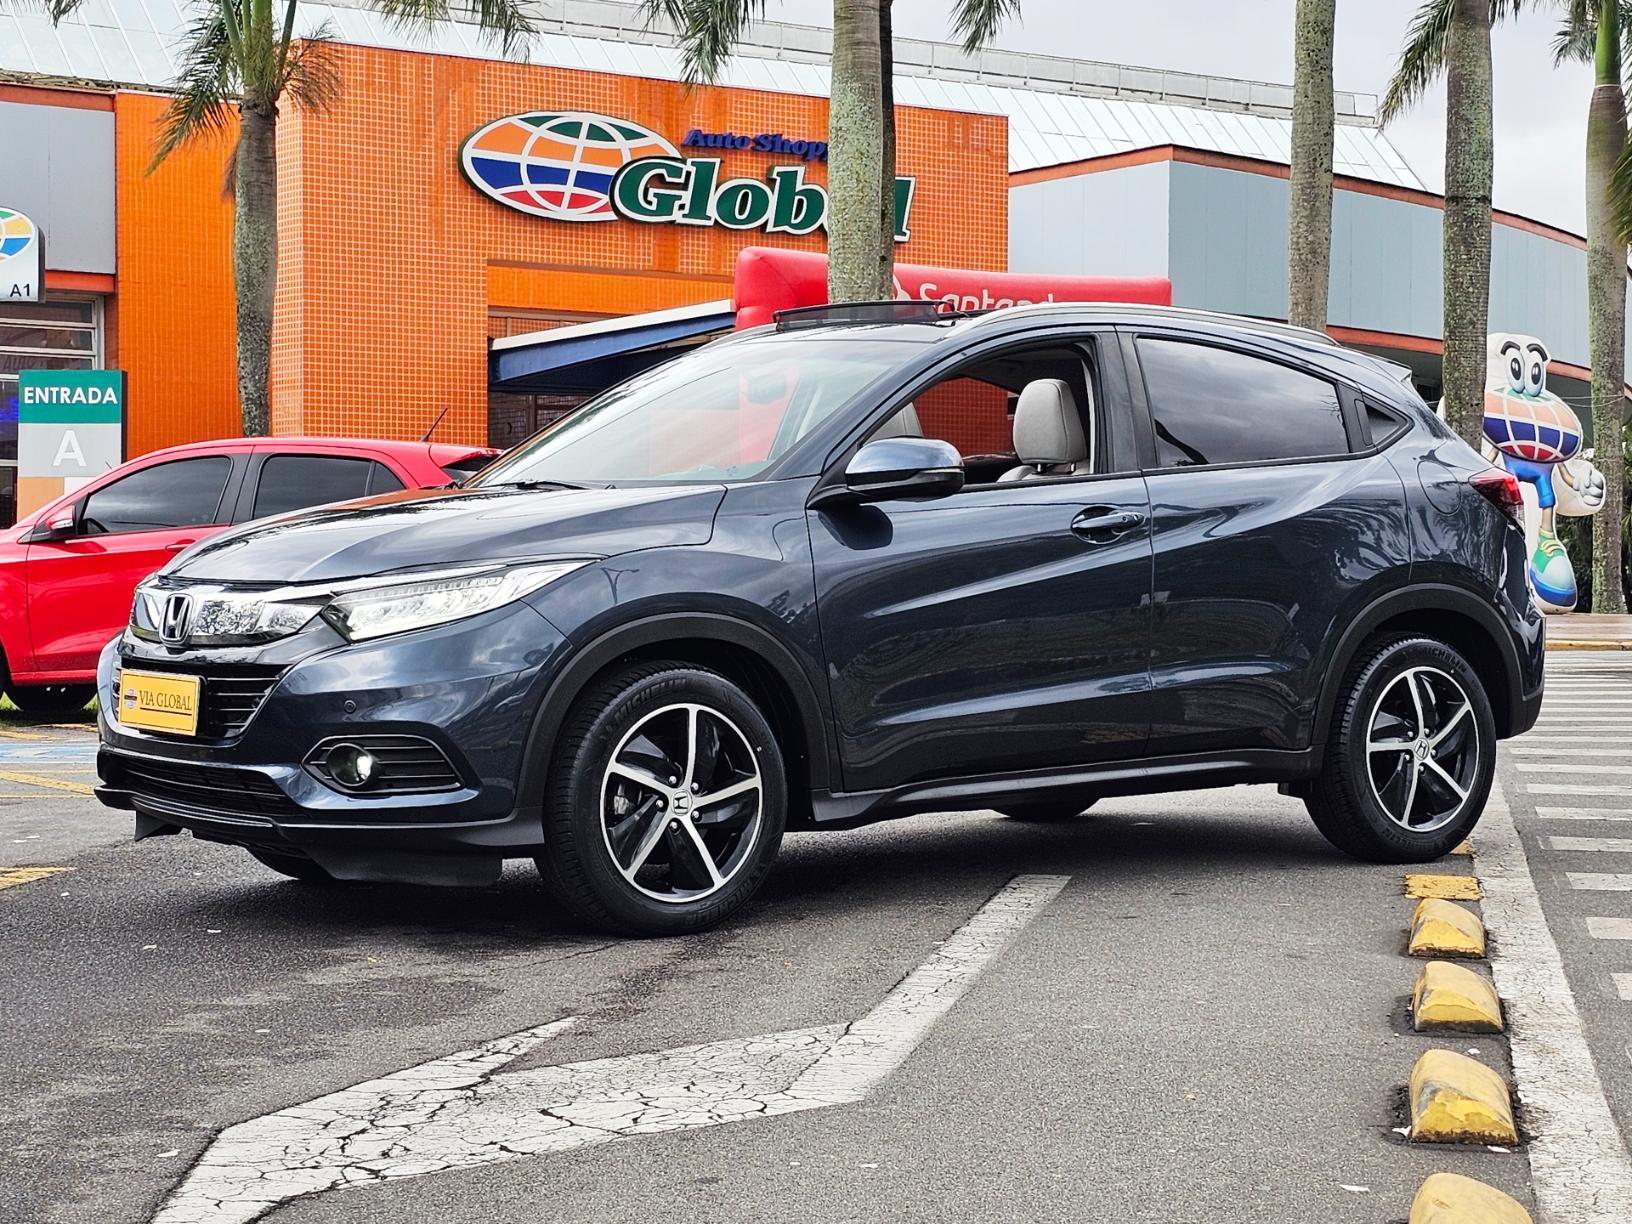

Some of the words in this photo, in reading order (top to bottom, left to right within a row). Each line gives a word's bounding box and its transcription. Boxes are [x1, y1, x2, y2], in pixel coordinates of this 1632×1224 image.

[681, 129, 751, 149] Auto
[752, 133, 828, 160] Shop
[609, 157, 916, 243] Globl
[10, 283, 31, 297] A1
[23, 387, 118, 405] ENTRADA
[52, 429, 87, 467] A
[139, 690, 155, 706] VIA
[156, 692, 192, 711] GLOBAL
